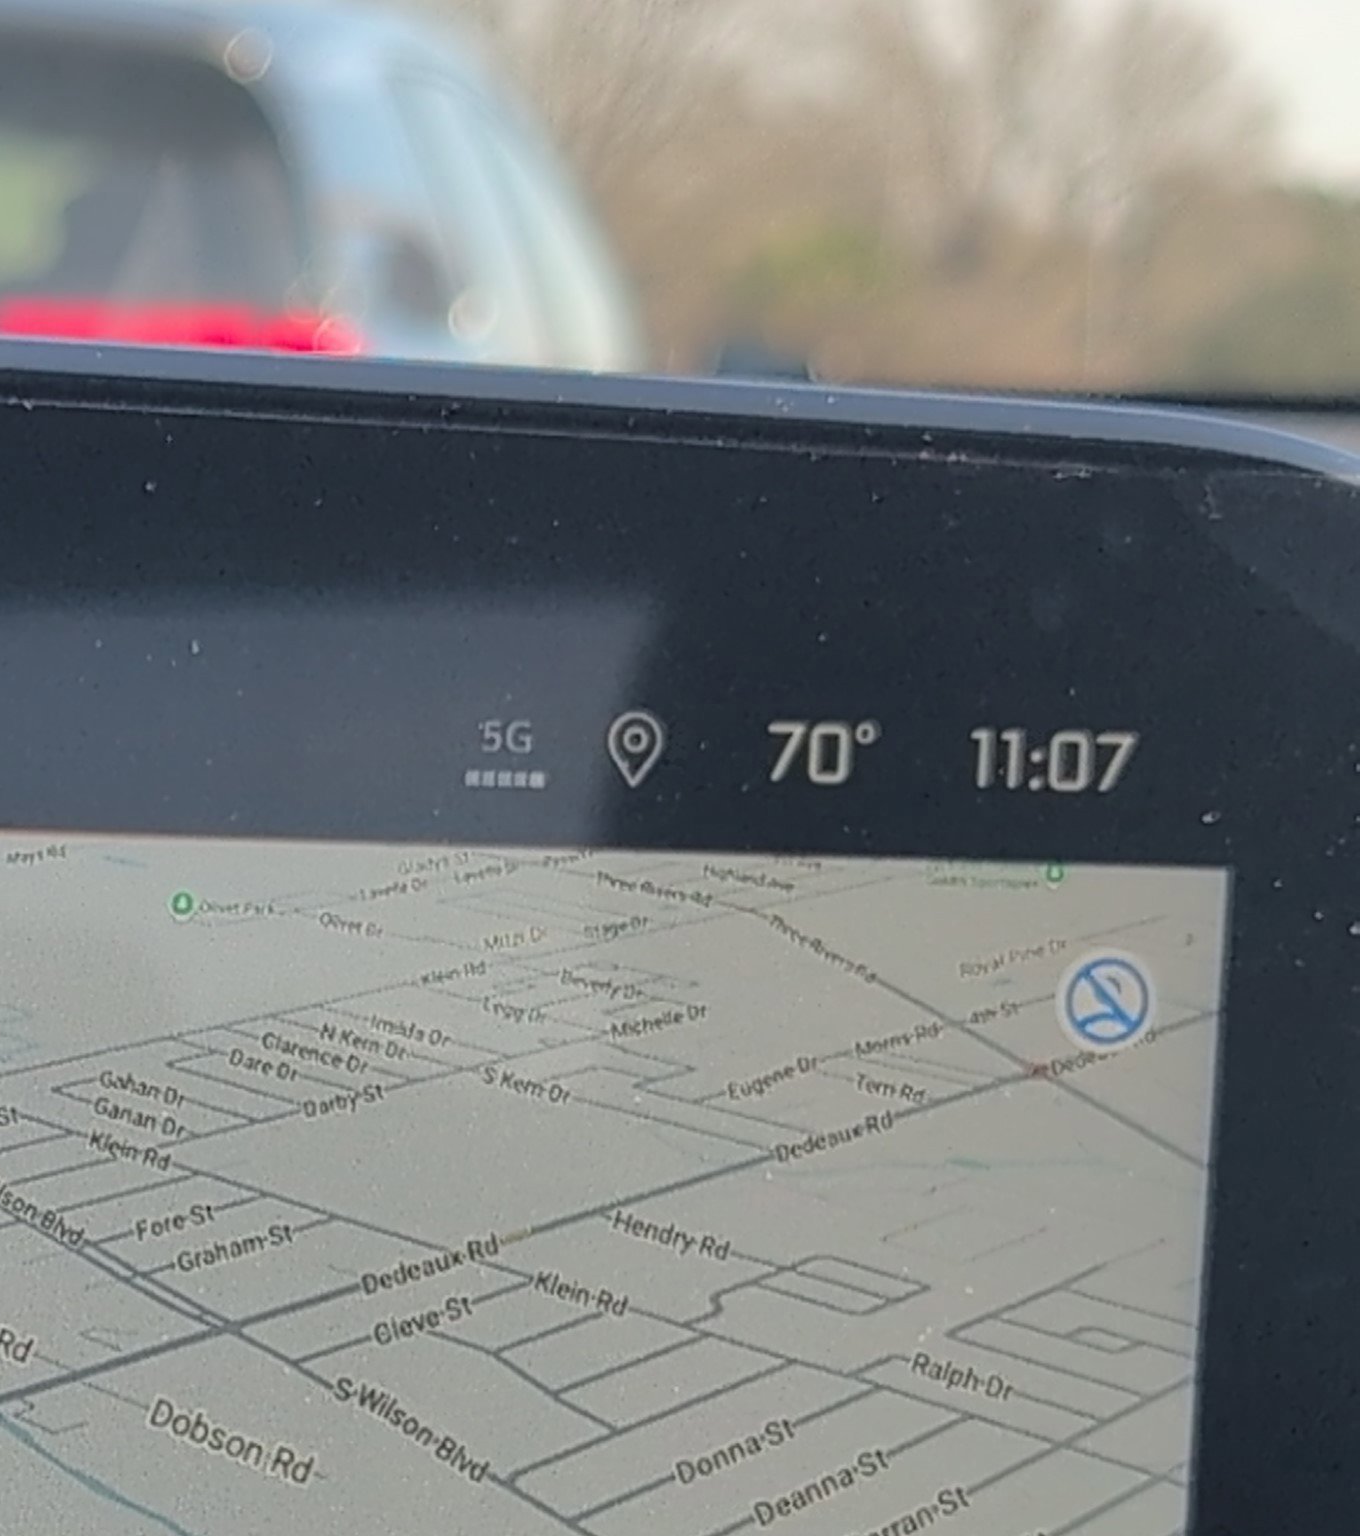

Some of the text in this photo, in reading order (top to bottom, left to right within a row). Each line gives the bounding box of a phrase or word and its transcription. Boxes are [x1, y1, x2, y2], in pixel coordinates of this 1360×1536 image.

[482, 721, 533, 753] 5G
[970, 729, 1138, 793] 11:07
[610, 1011, 683, 1039] Michelle
[261, 1031, 343, 1069] Clarence
[361, 1083, 384, 1103] St
[483, 1065, 497, 1086] S
[727, 1053, 818, 1101] Eugene Dr
[141, 1146, 172, 1172] Rd
[775, 1110, 895, 1163] Dedeaux Rd
[39, 1211, 86, 1248] Blvd
[189, 1204, 216, 1227] St
[611, 1208, 731, 1262] Hendry Rd
[176, 1224, 293, 1275] Graham St
[360, 1232, 501, 1297] Dedeaux Rd
[534, 1271, 630, 1319] Klein Rd
[372, 1295, 475, 1347] Cleve St
[910, 1351, 1016, 1402] Ralph Dr
[148, 1397, 317, 1486] Dobson Rd
[332, 1376, 493, 1486] S Wilson Blvd
[674, 1416, 796, 1486] Donna St
[752, 1447, 890, 1528] Deanna St
[935, 1483, 971, 1520] St
